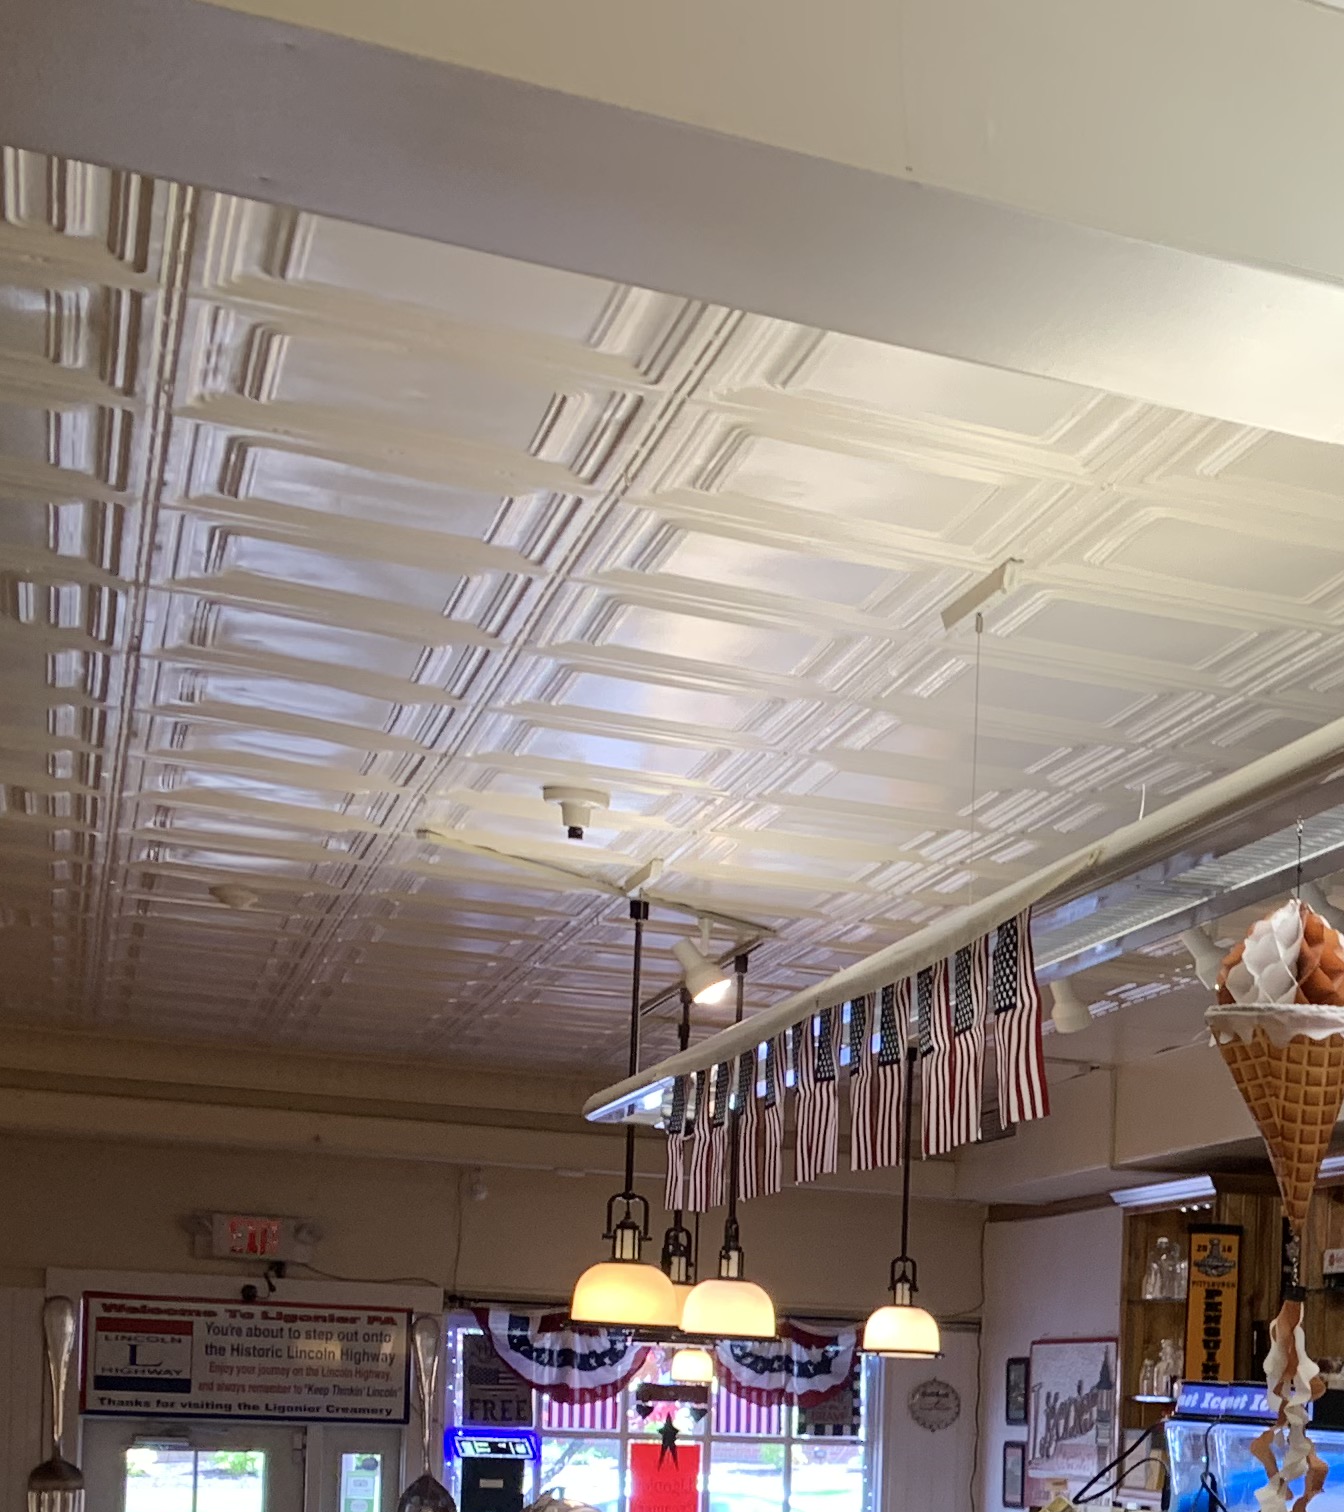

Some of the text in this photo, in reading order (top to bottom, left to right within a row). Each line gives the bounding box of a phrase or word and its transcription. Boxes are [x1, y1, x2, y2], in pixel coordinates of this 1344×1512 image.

[101, 1302, 397, 1325] Welcome To Ligonier PA
[104, 1335, 182, 1344] LINCOLN
[205, 1321, 392, 1344] You're about to step out onto
[205, 1342, 395, 1367] the Historic Lincoln Highway
[101, 1367, 183, 1376] HIGHWAY
[98, 1397, 392, 1416] Thanks for visiting the Ligonier Creamery
[468, 1398, 527, 1422] FREE
